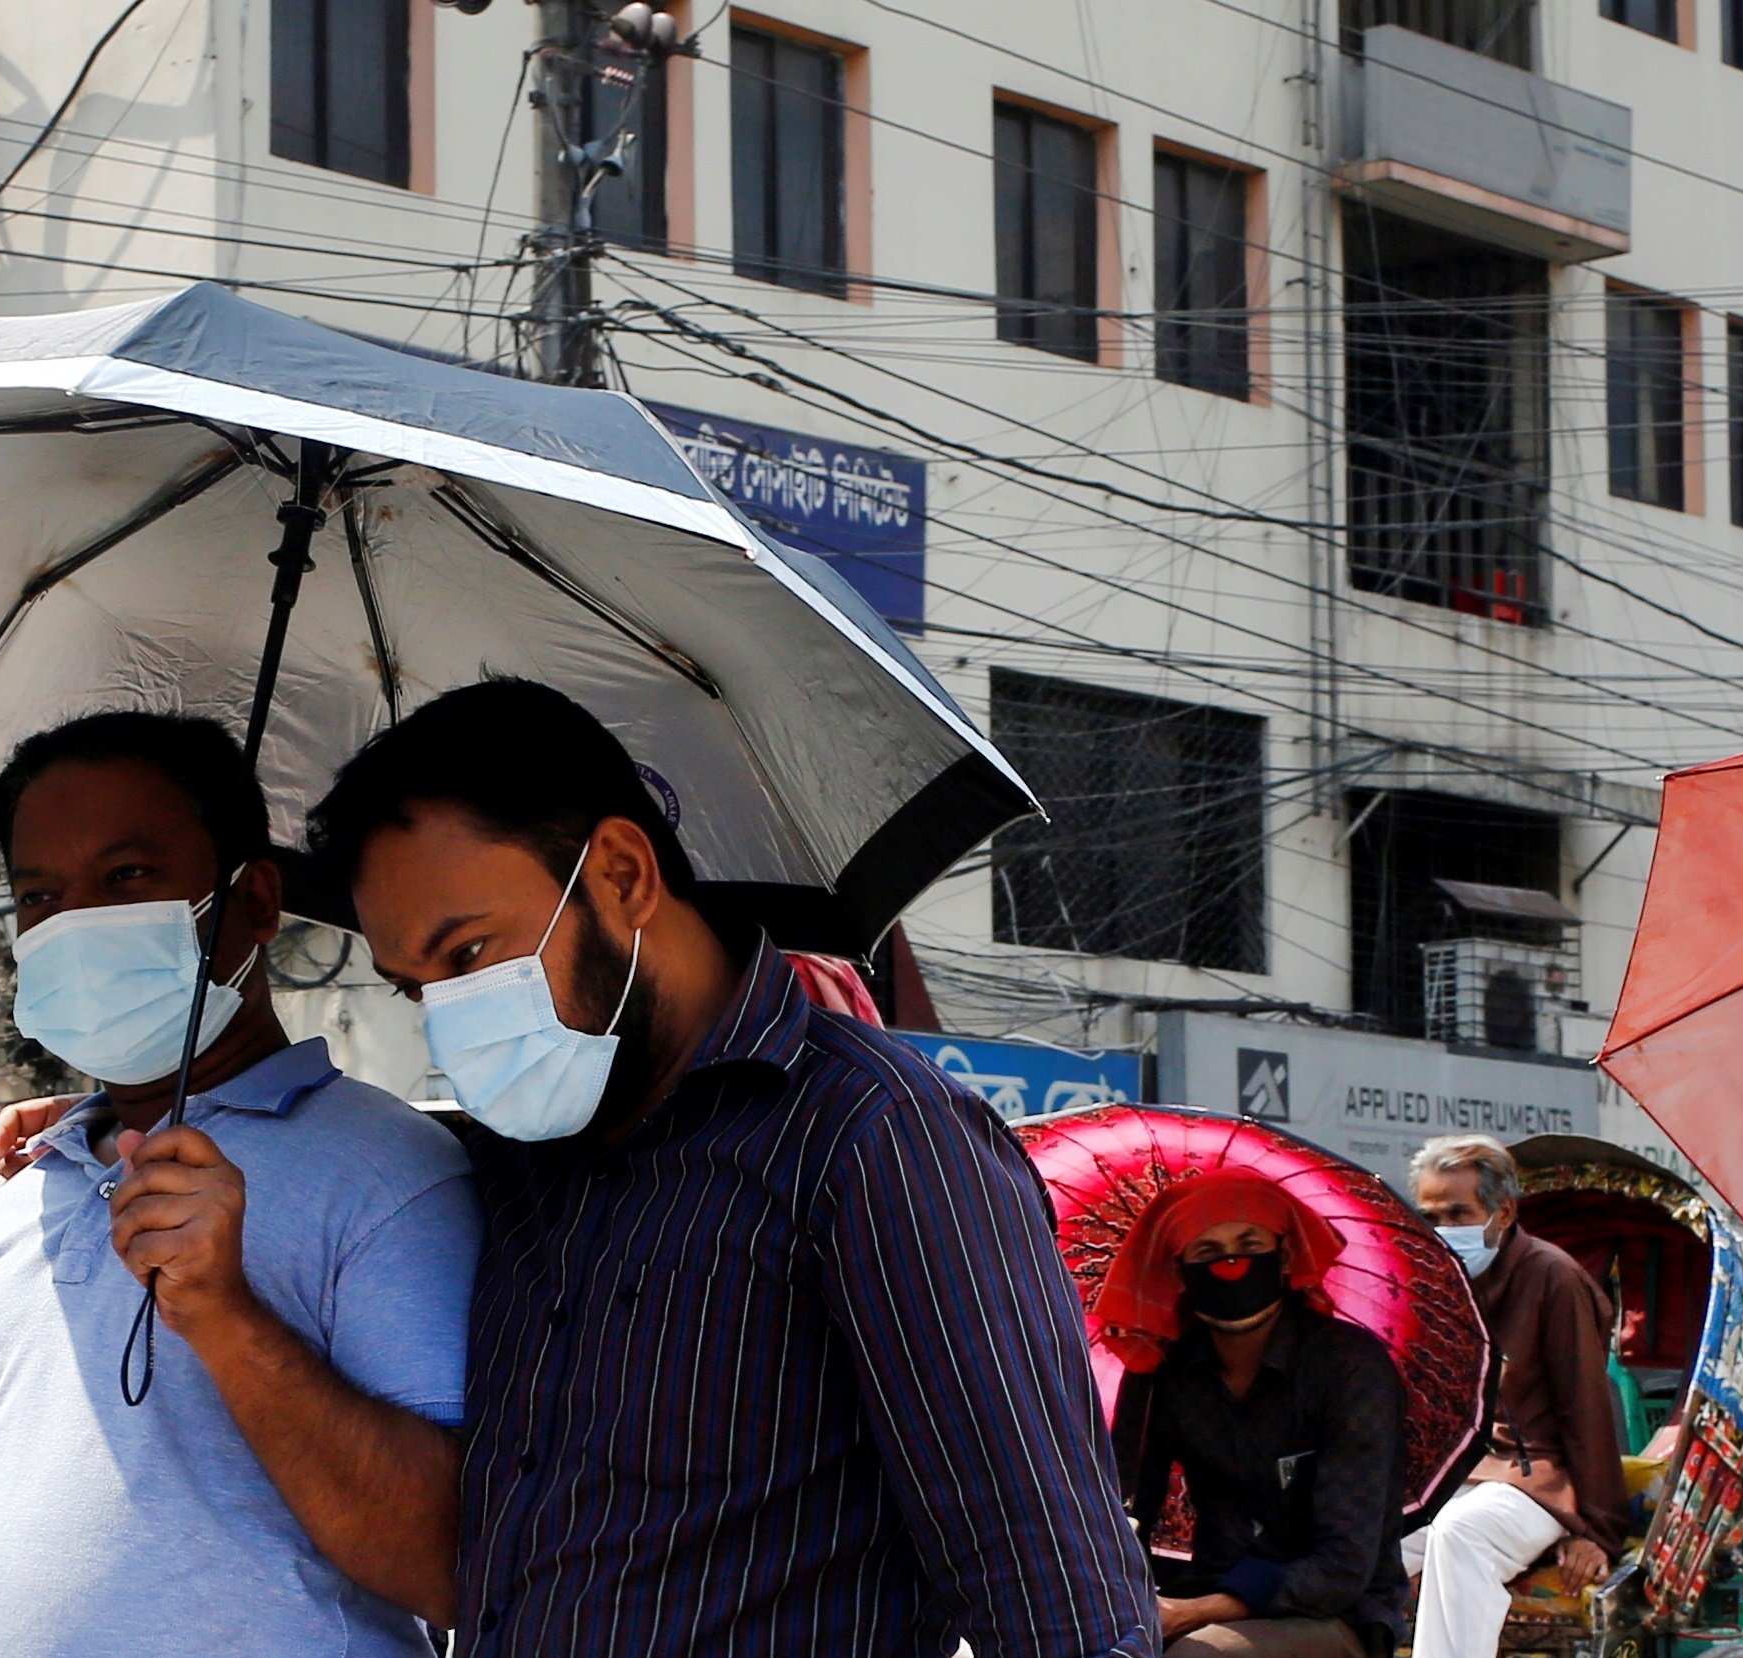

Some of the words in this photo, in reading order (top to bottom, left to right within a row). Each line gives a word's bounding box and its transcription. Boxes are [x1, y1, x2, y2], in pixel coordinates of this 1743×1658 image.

[831, 452, 912, 527] লিমিটেড
[1345, 1086, 1430, 1124] APPLIED
[1437, 1095, 1573, 1135] INSTRUMENTS
